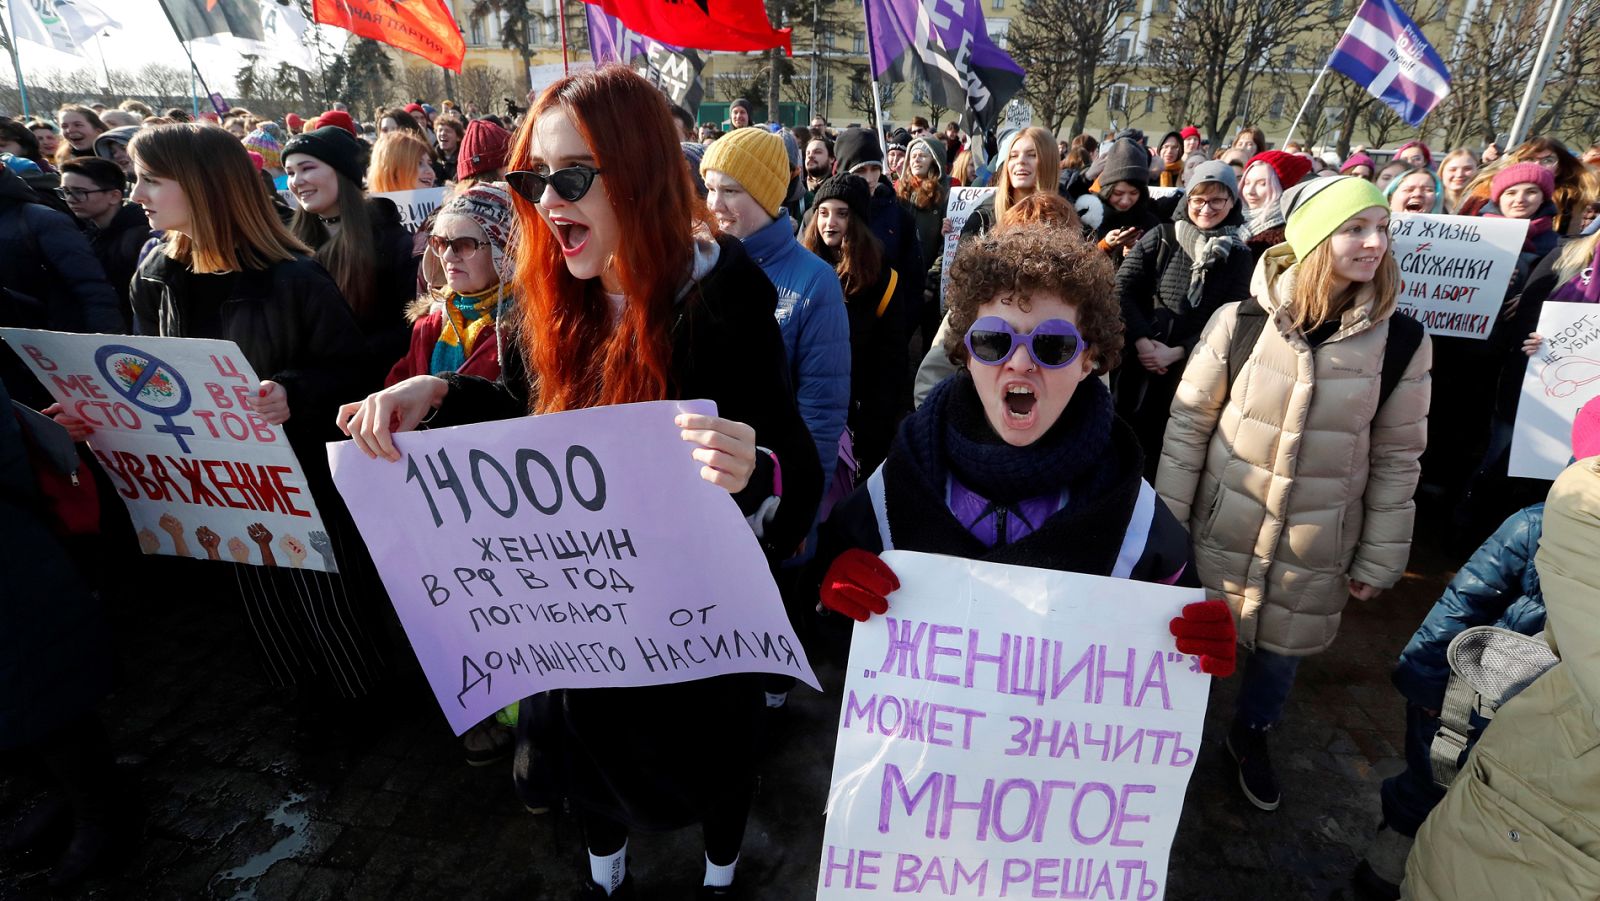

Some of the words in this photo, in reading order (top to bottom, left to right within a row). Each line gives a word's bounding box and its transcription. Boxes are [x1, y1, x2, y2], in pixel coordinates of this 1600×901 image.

[387, 17, 443, 54] ПАРТИЯ
[1388, 48, 1416, 72] myself
[1418, 221, 1481, 243] ЖИЗНЬ
[1400, 252, 1494, 280] СЛУЖАНКИ
[1408, 281, 1427, 299] НА
[1431, 283, 1480, 304] АБОРТ
[1422, 310, 1490, 334] РОССИЯНКИ
[21, 344, 58, 371] В
[210, 354, 248, 382] Ц
[1541, 351, 1562, 365] НЕ
[49, 373, 108, 399] МЕ
[204, 382, 251, 412] ВЕ
[74, 401, 142, 430] СТО
[192, 410, 277, 443] ТОВ
[99, 450, 312, 518] УВАЖЕНИЕ
[406, 445, 606, 528] 14000
[472, 529, 636, 563] ЖЕНЩИН
[421, 574, 450, 606] В
[454, 567, 501, 597] РФ
[517, 569, 548, 590] В
[562, 568, 635, 593] ГОД
[469, 603, 627, 632] ПОГИБАЮТ
[669, 605, 717, 627] ОТ
[457, 642, 625, 709] ДОМАШНЕГО
[635, 630, 801, 672] НАСИЛИЯ
[843, 690, 986, 750] МОЖЕТ
[1004, 716, 1195, 767] ЗНАЧИТЬ
[878, 763, 1156, 848] МНОГОЕ
[824, 846, 882, 890] НЕ
[893, 853, 988, 897] ВАМ
[999, 858, 1158, 901] РЕШАТЬ
